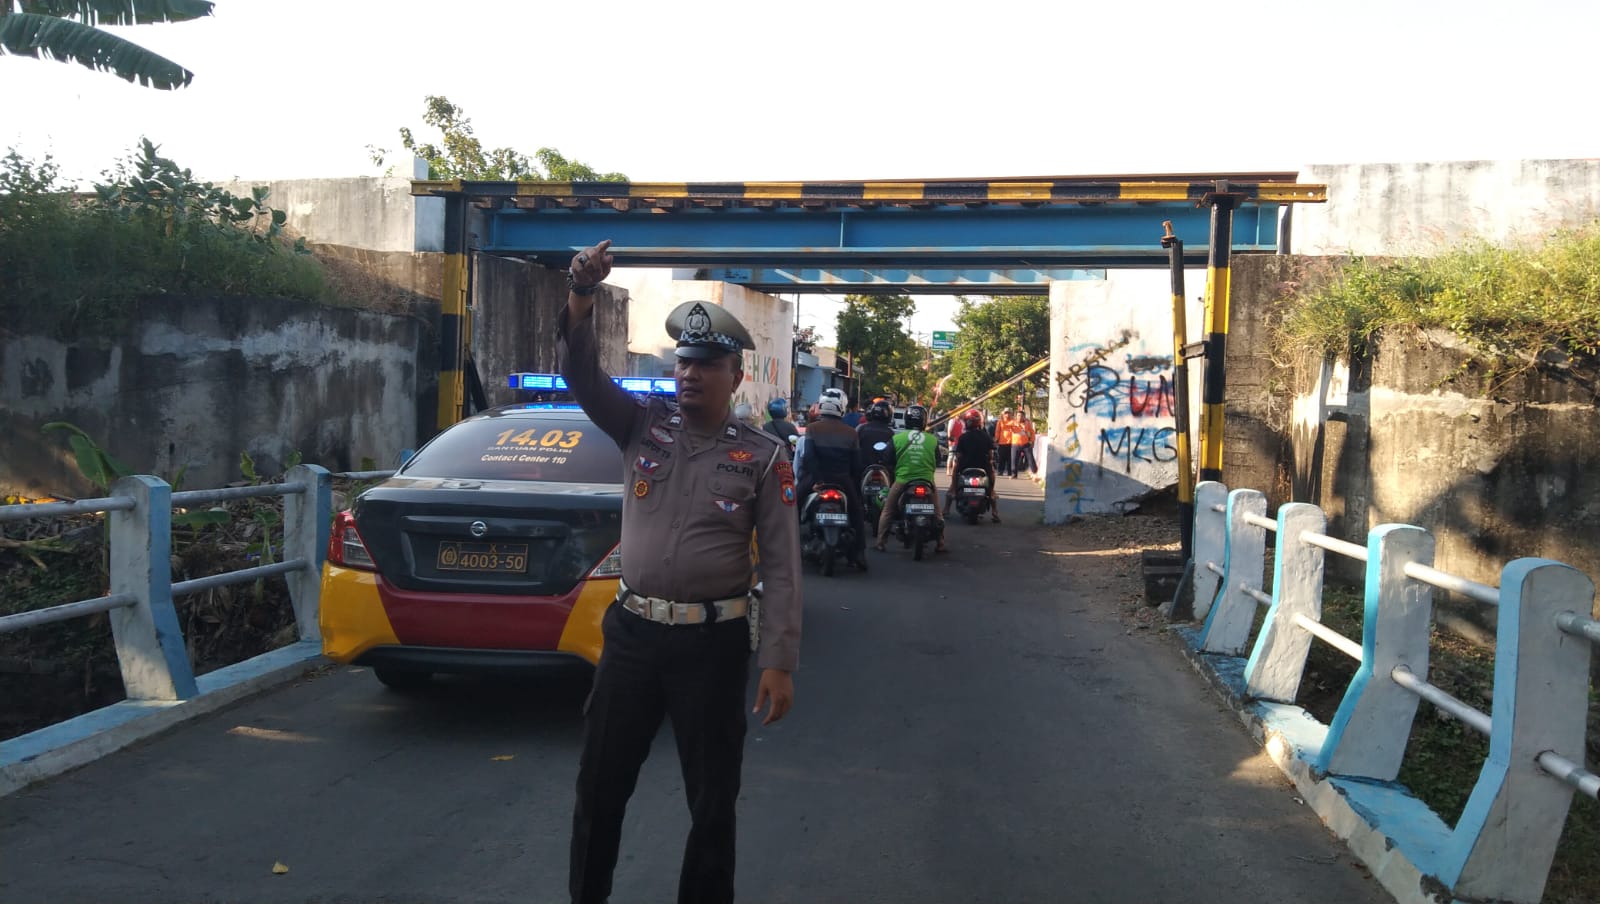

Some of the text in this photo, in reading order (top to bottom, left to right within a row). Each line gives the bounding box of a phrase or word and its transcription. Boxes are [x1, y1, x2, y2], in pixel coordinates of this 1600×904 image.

[496, 428, 583, 448] 14.03
[481, 453, 567, 465] Contact Center 110
[717, 464, 754, 476] POLRI
[460, 554, 524, 569] 4003-50
